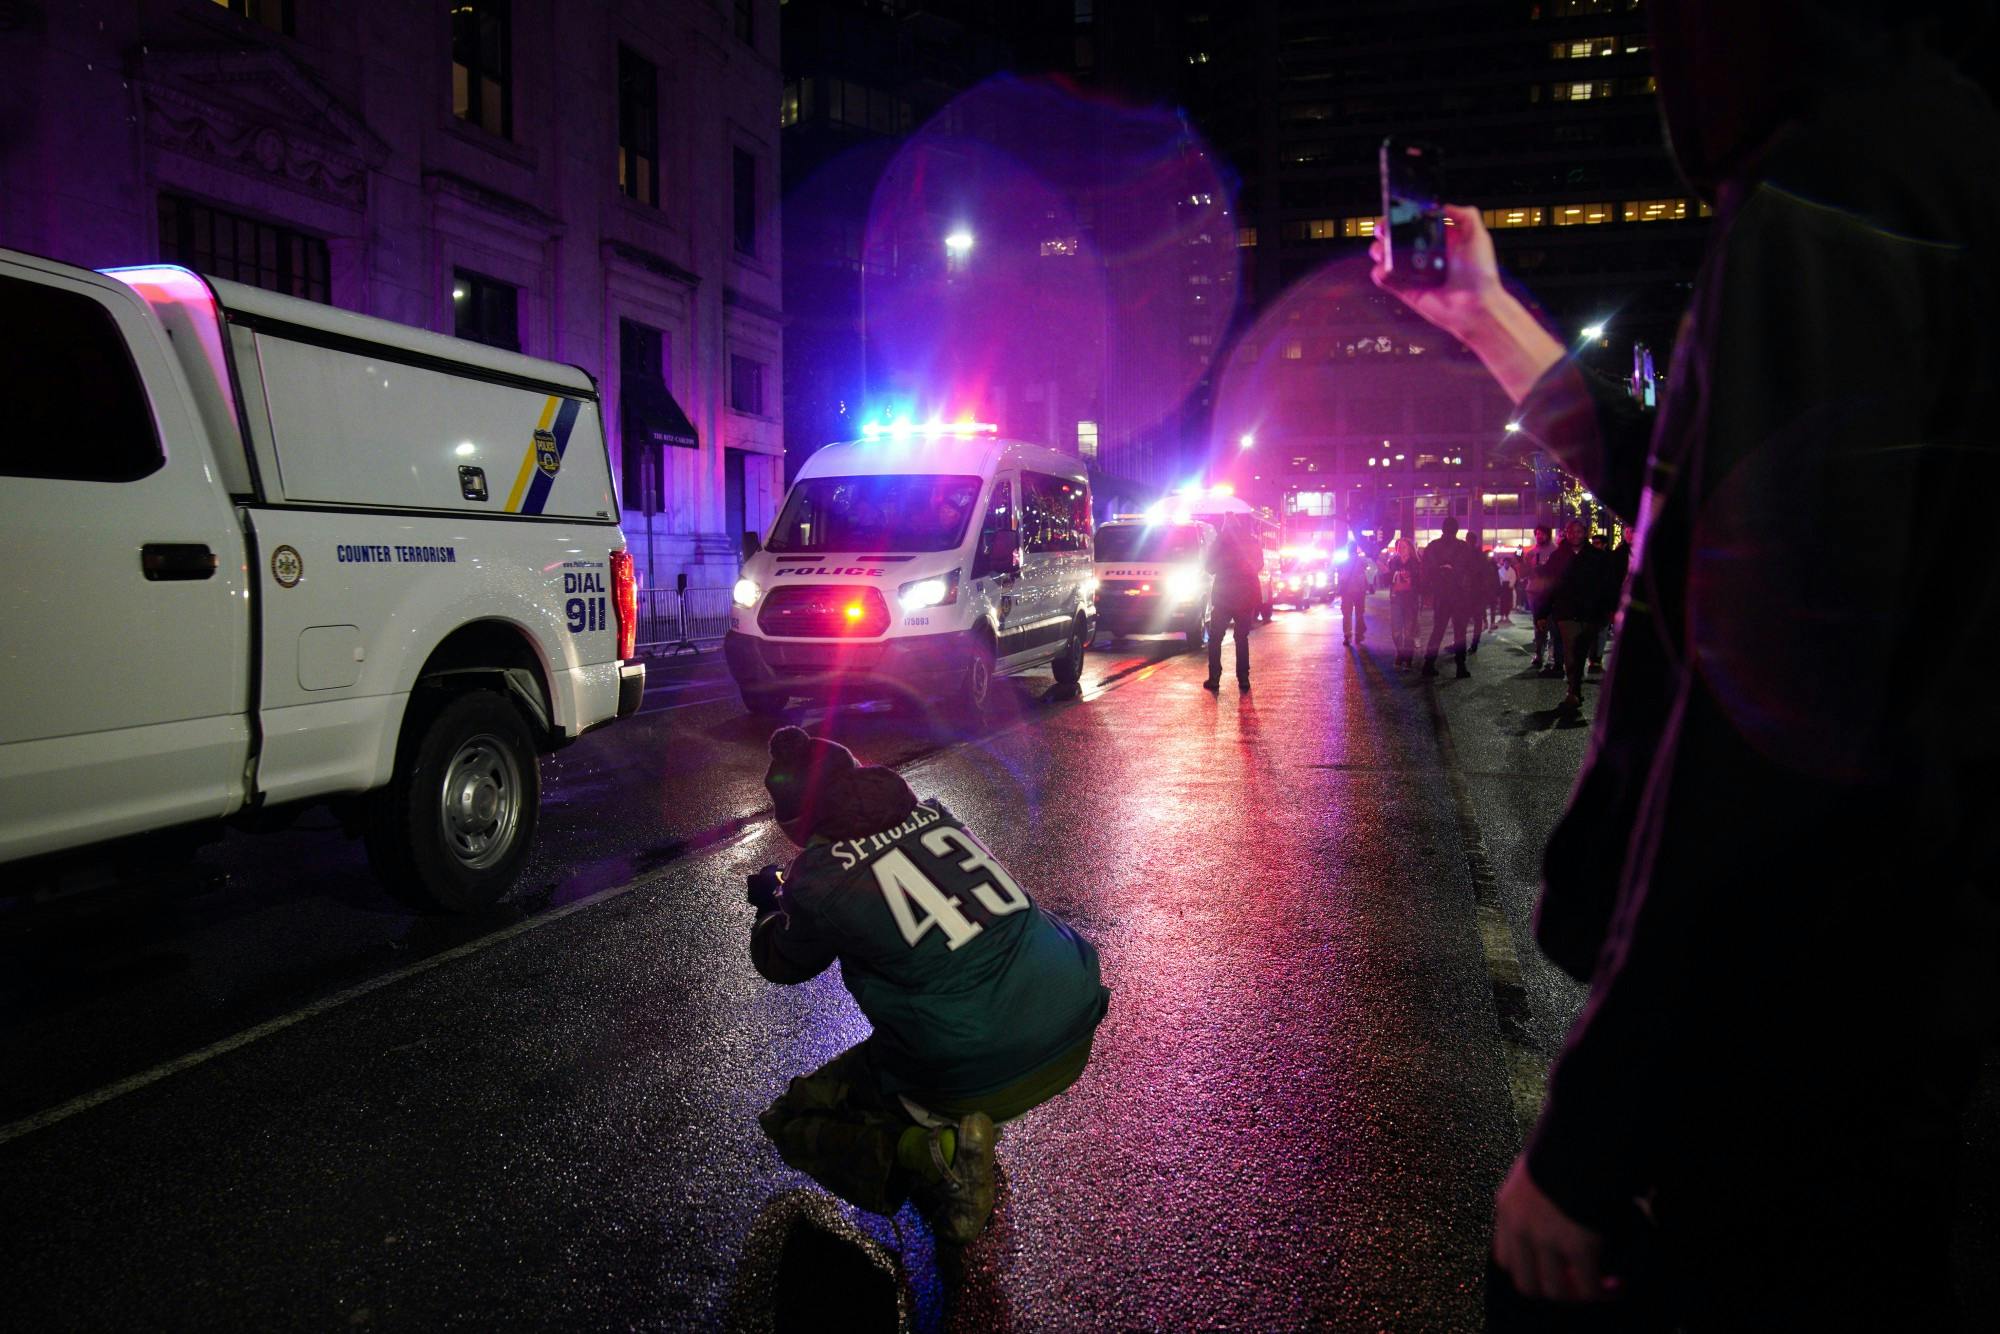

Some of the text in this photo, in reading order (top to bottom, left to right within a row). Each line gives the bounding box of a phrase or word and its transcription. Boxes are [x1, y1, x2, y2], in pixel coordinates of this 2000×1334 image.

[336, 544, 456, 562] COUNTER TERRORISM
[564, 572, 606, 593] DIAL
[774, 567, 886, 577] POLICE
[566, 597, 606, 633] 911
[869, 825, 1031, 952] 43
